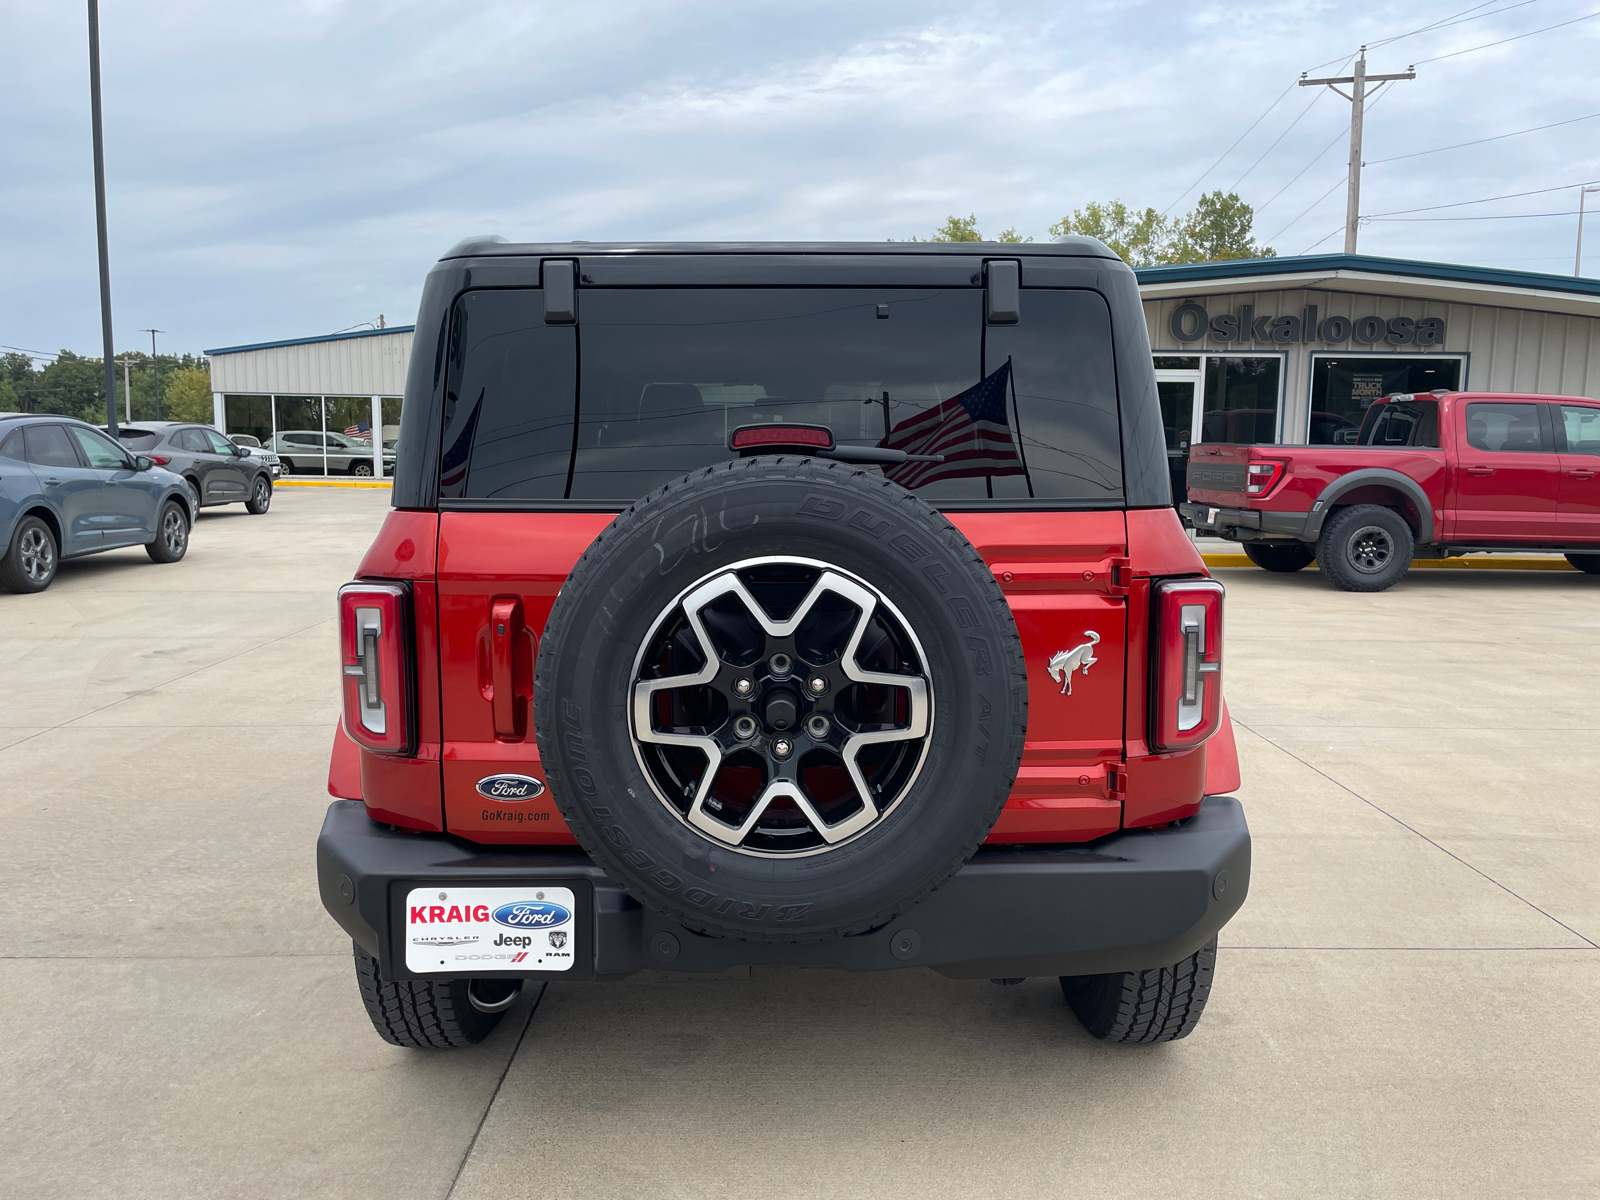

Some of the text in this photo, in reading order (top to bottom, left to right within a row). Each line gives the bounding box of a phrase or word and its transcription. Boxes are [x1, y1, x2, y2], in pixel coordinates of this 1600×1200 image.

[1170, 303, 1445, 345] Oskaloosa
[1193, 471, 1237, 482] FORD
[794, 493, 997, 677] DUELER
[491, 780, 528, 796] Ford
[482, 809, 550, 823] GoKraig.com
[560, 697, 814, 922] BRIDGESTONE
[411, 905, 556, 925] KRAIG Ford
[493, 933, 532, 949] Jeep
